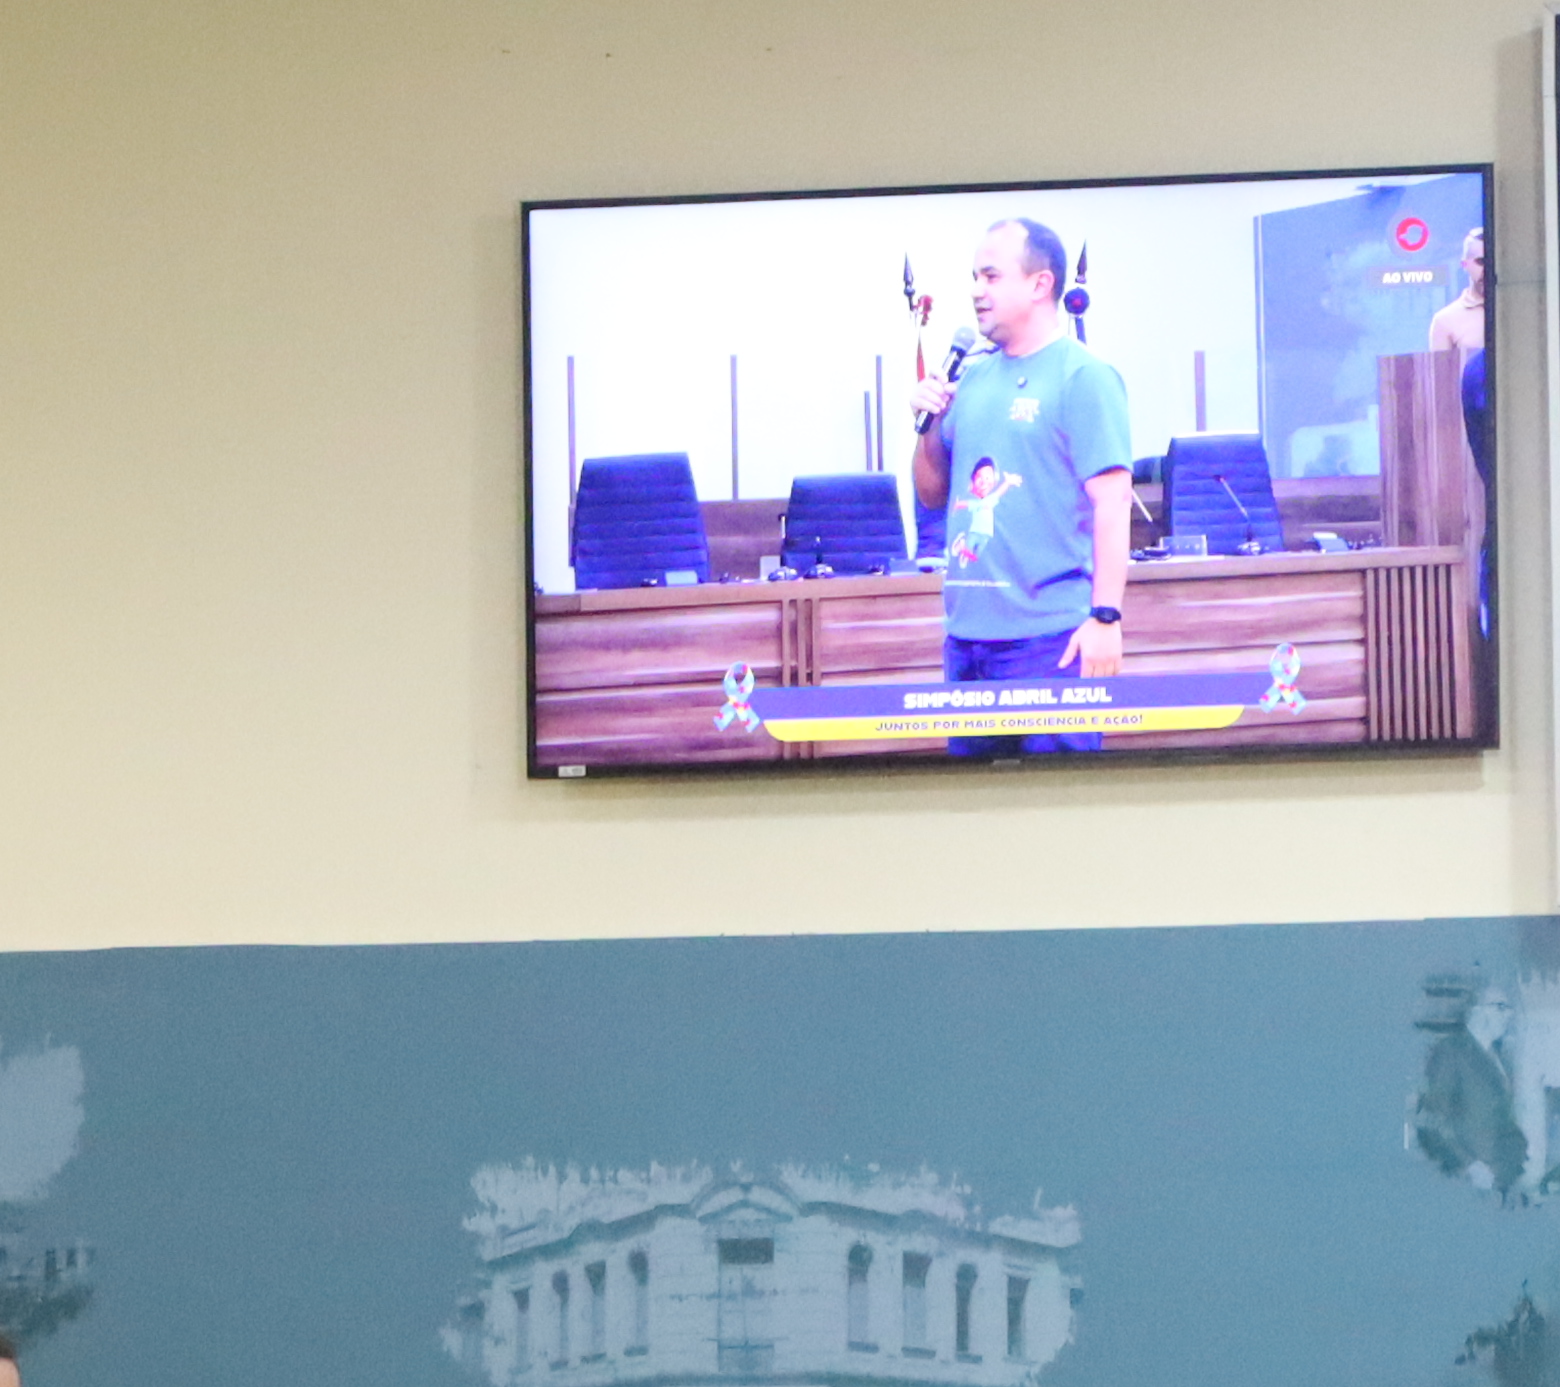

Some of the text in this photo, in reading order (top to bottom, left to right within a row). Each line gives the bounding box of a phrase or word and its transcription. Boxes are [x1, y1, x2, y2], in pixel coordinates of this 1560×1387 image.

[1402, 271, 1433, 283] VIVO
[903, 686, 1112, 709] SIMPÓSIO ABRIL AZUL
[875, 721, 928, 731] JUNTOS
[933, 720, 960, 730] POR
[964, 719, 996, 729] MAIS
[1091, 715, 1100, 725] E
